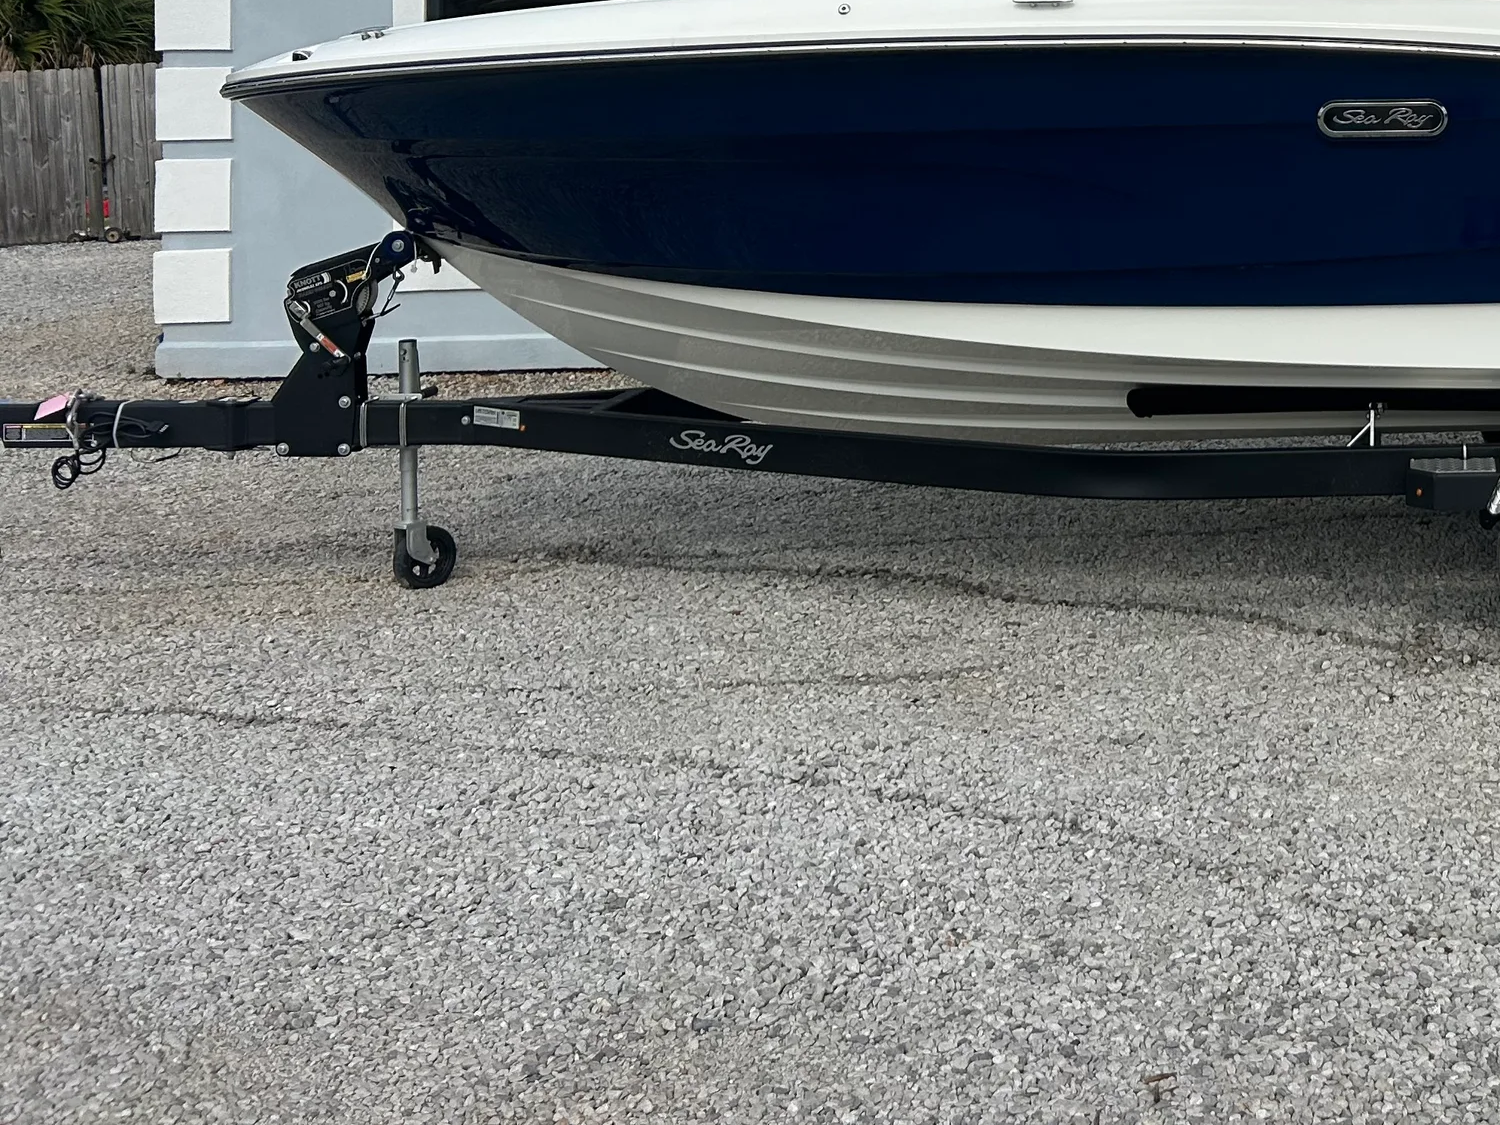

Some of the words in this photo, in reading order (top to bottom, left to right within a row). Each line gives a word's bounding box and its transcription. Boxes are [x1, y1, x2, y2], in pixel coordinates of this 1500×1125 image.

[1333, 109, 1381, 124] Sea
[1384, 107, 1433, 128] Ray
[293, 274, 321, 289] KNOTT
[669, 429, 722, 452] Sea
[720, 434, 774, 465] Ray
